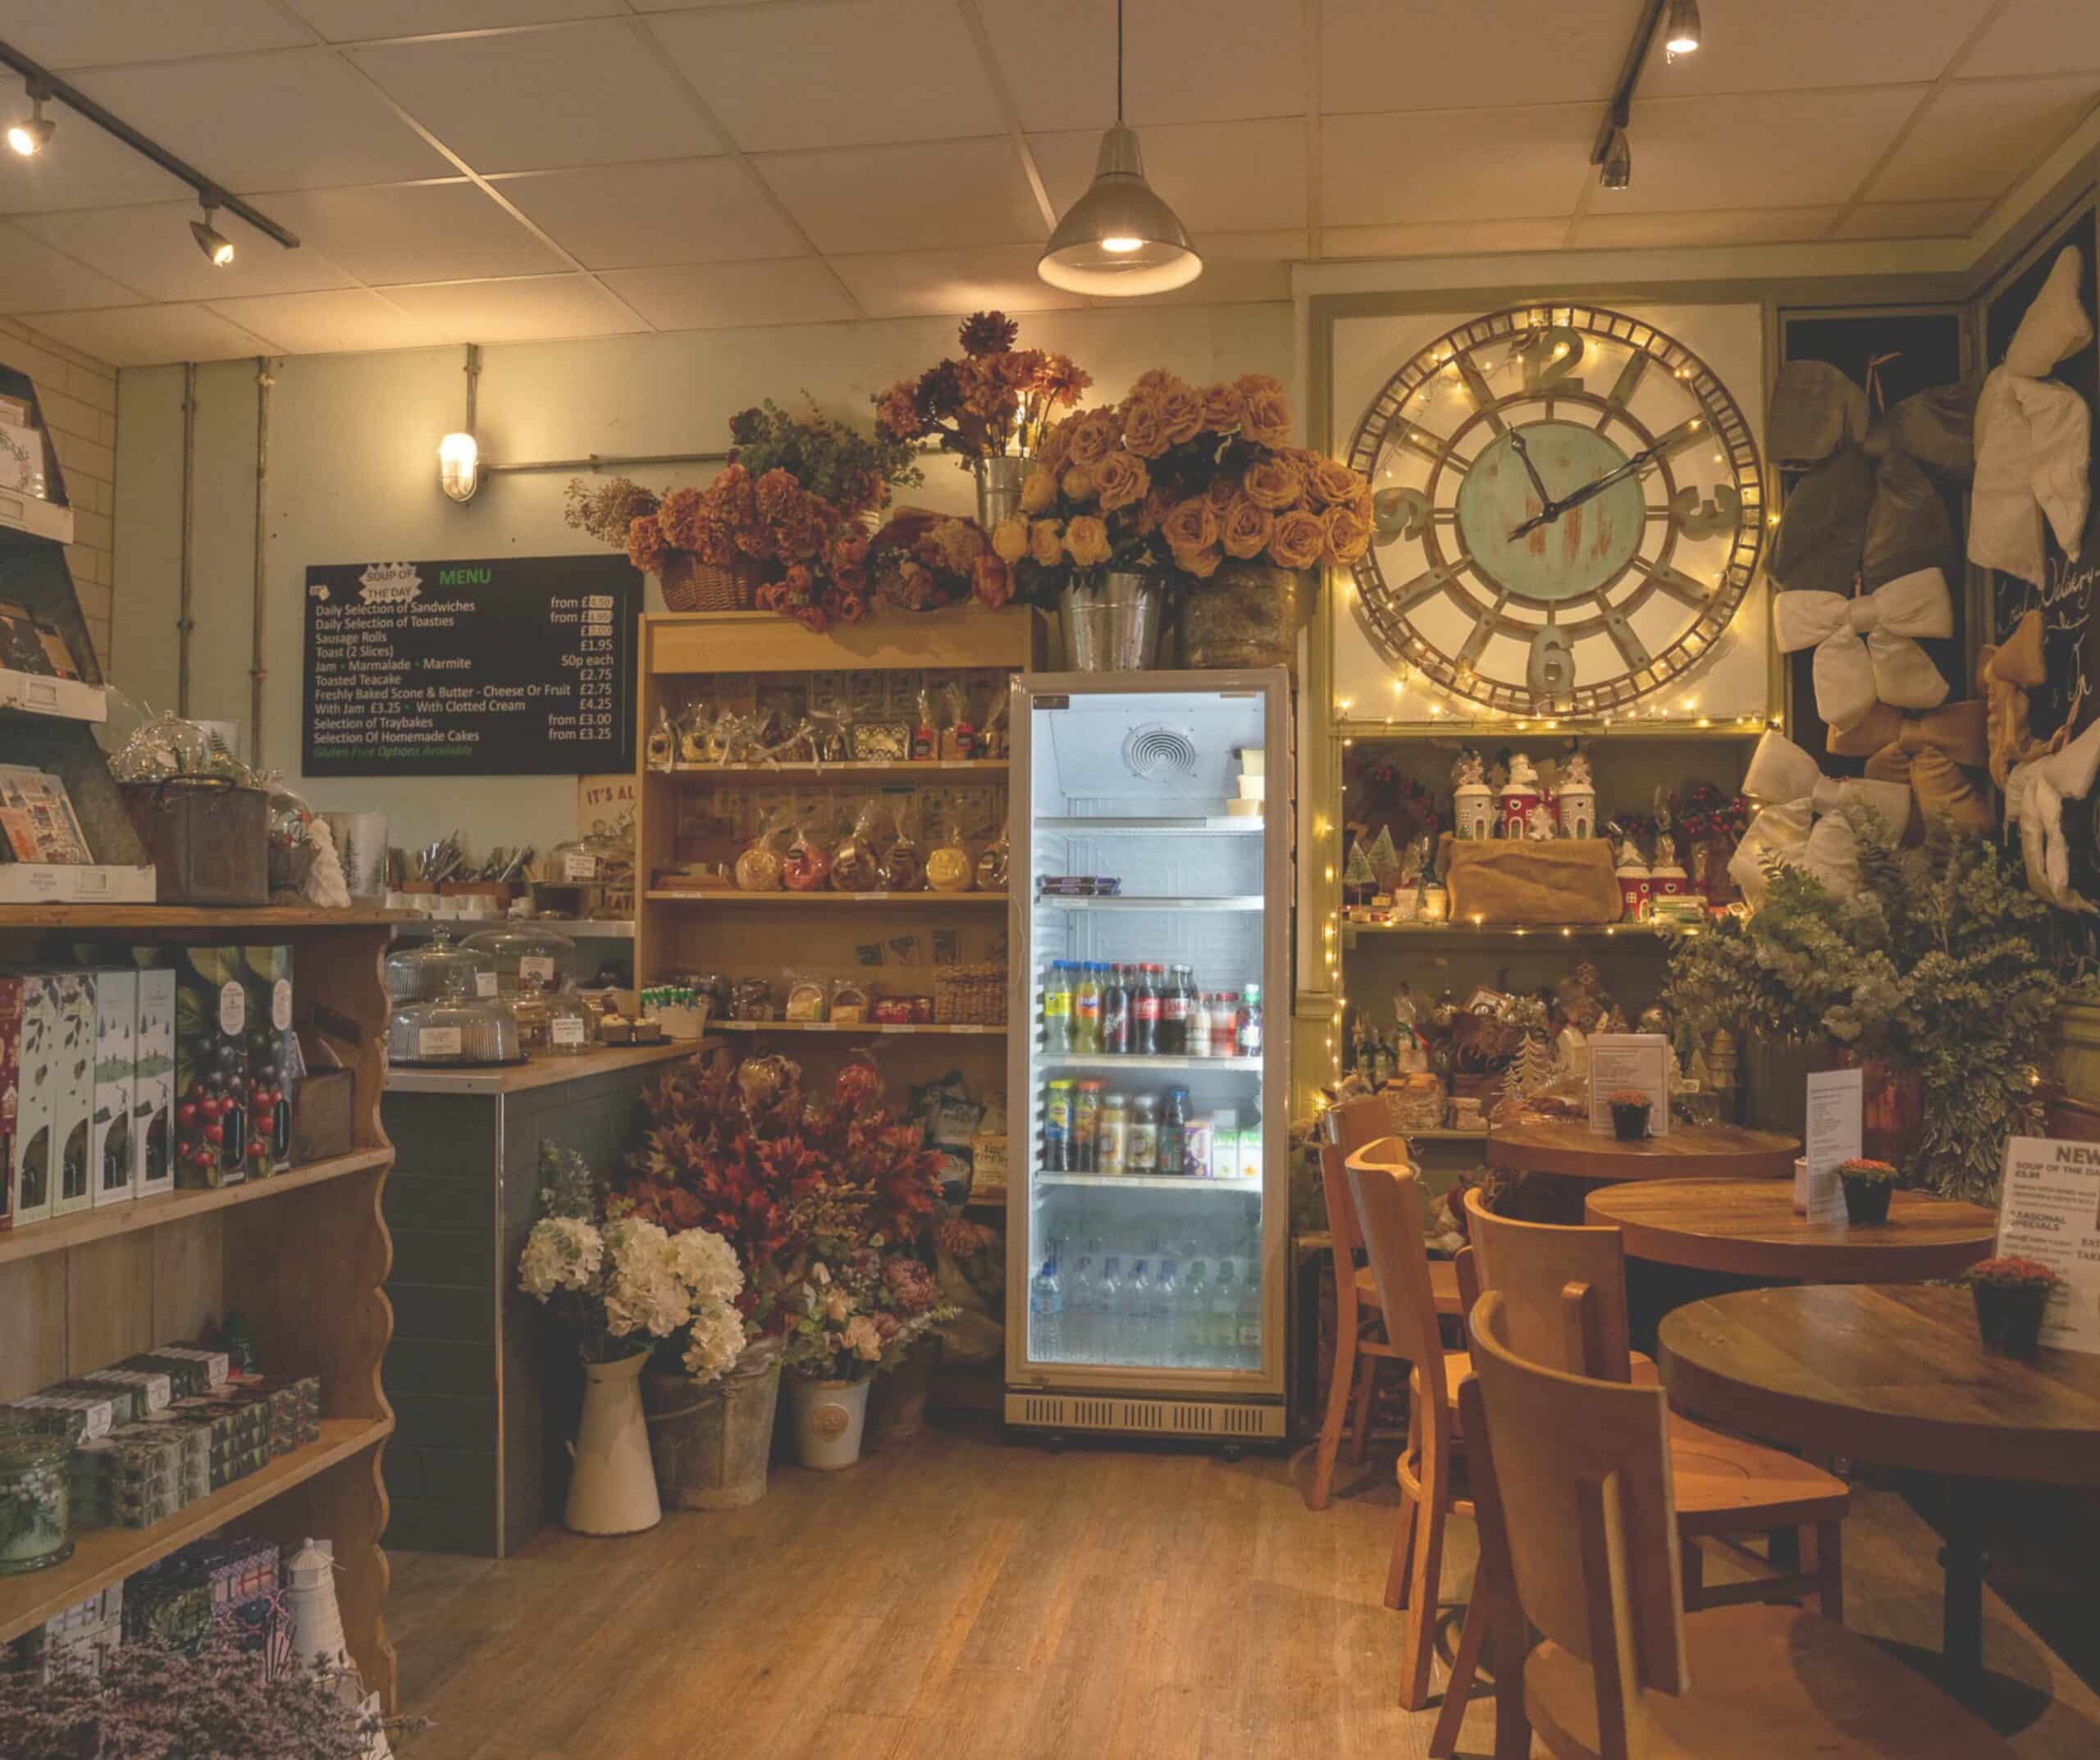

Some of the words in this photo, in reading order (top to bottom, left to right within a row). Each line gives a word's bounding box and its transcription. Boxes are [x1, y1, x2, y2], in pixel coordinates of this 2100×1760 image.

[1677, 485, 1739, 540] 3
[368, 572, 395, 581] SOUP
[399, 570, 413, 578] OF
[439, 568, 492, 585] MENU
[368, 589, 388, 598] THE
[391, 588, 411, 596] DAY
[551, 595, 578, 609] from
[316, 606, 342, 617] Daily
[345, 604, 394, 615] Selection
[397, 604, 408, 613] of
[411, 601, 475, 613] Sandwiches
[316, 618, 342, 631] Daily
[345, 618, 394, 629] Selection
[397, 617, 408, 627] of
[411, 616, 454, 627] Toasties
[550, 611, 578, 623] from
[316, 633, 359, 645] Sausage
[362, 632, 387, 642] Rolls
[581, 640, 613, 650] £1.95
[316, 649, 344, 658] Toast
[347, 648, 357, 658] (2
[360, 647, 394, 658] Slices)
[315, 663, 337, 672] Jam
[349, 660, 411, 671] Marmalade
[423, 658, 472, 669] Marmite
[562, 655, 583, 669] 50p
[587, 654, 614, 666] each
[1527, 628, 1575, 705] 6
[315, 676, 356, 686] Toasted
[360, 674, 401, 685] Teacake
[580, 669, 612, 680] £2.75
[315, 690, 354, 701] Freshly
[356, 689, 388, 699] Baked
[391, 689, 422, 698] Scone
[427, 687, 436, 697] &
[440, 687, 473, 697] Butter
[484, 686, 524, 696] Cheese
[527, 685, 541, 695] Or
[545, 685, 571, 695] Fruit
[580, 685, 612, 695] £2.75
[315, 704, 340, 714] With
[343, 704, 364, 714] Jam
[371, 702, 400, 713] £3.25
[416, 702, 443, 713] With
[446, 700, 486, 712] Clotted
[489, 700, 525, 711] Cream
[579, 699, 611, 709] £4.25
[314, 719, 363, 729] Selection
[366, 718, 377, 727] of
[381, 717, 433, 729] Traybakes
[549, 714, 576, 726] from
[579, 714, 611, 725] £3.00
[314, 732, 363, 743] Selection
[366, 732, 378, 742] Of
[381, 732, 445, 742] Homemade
[448, 729, 480, 741] Cakes
[549, 728, 576, 740] from
[579, 728, 611, 740] £3.25
[587, 787, 612, 805] IT'S
